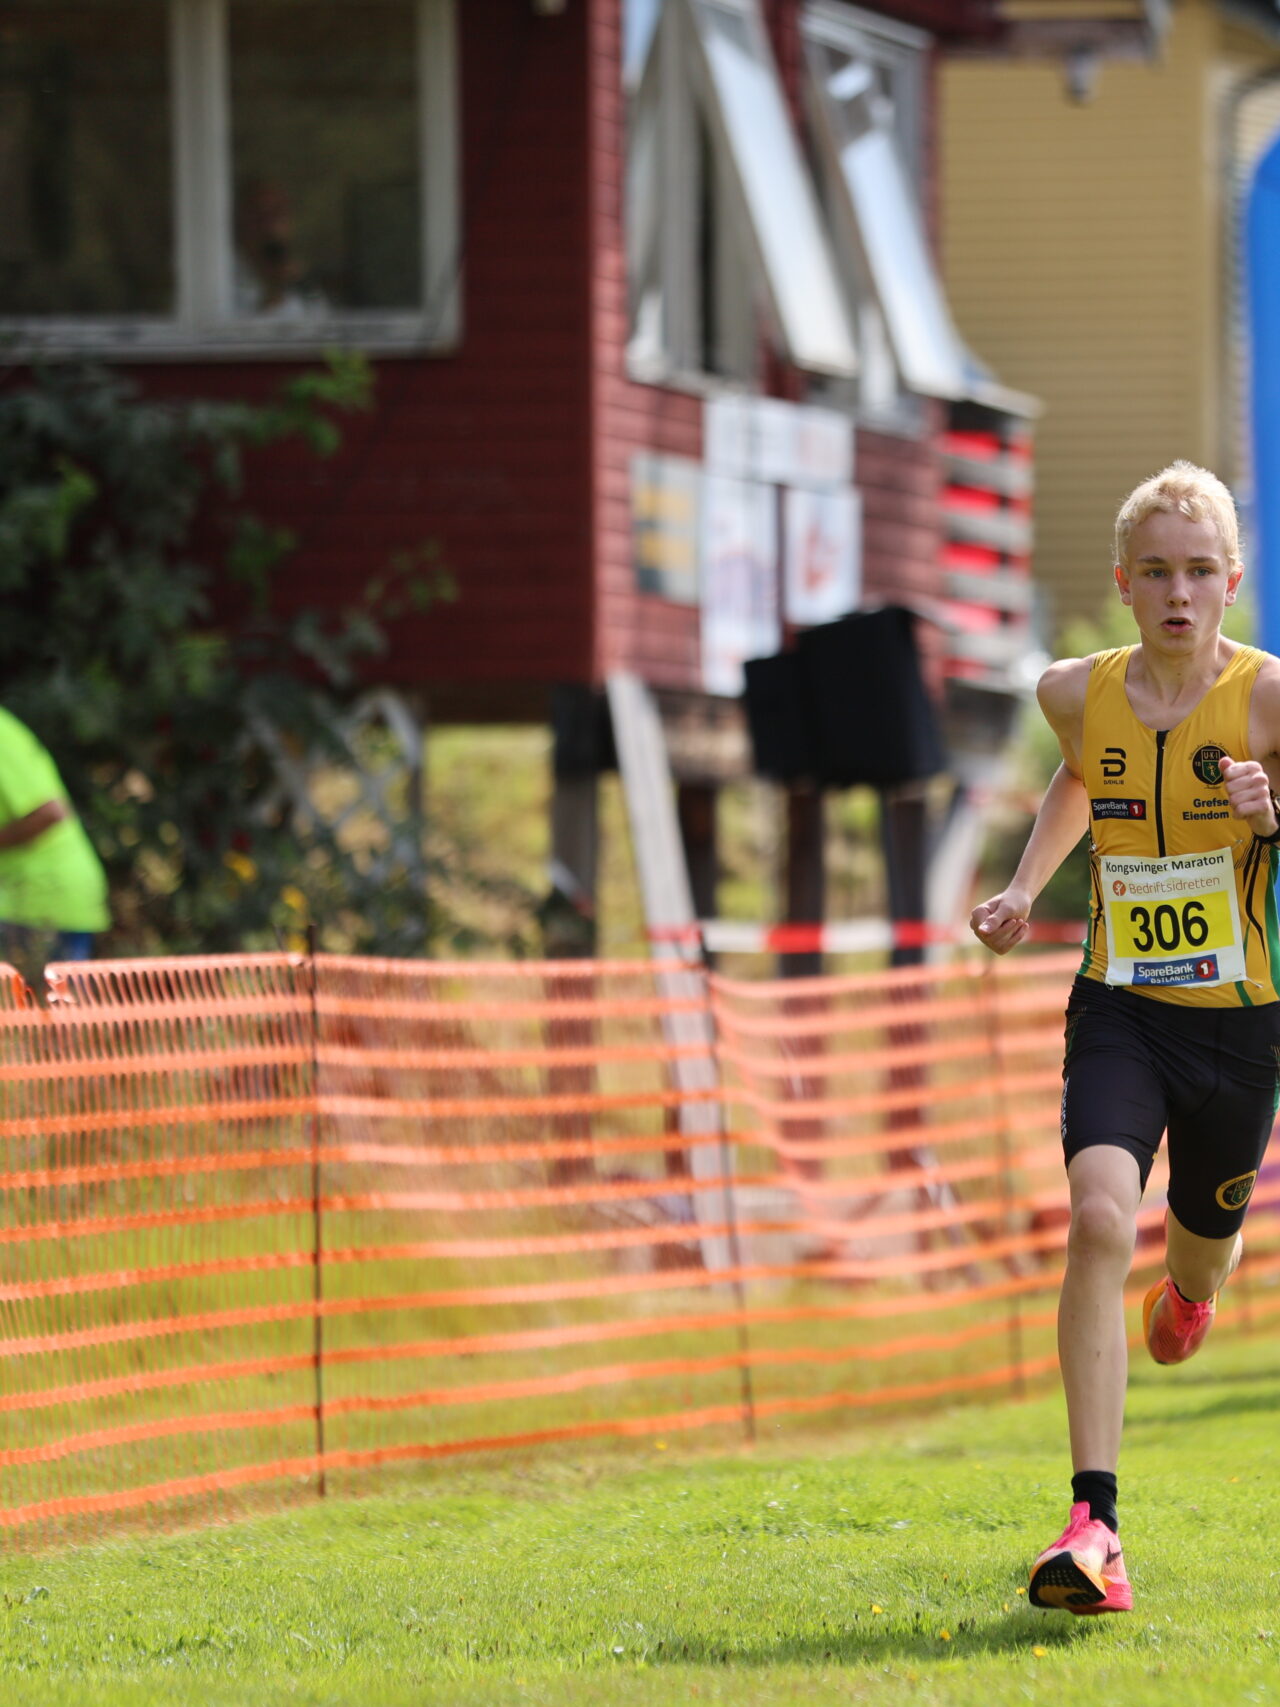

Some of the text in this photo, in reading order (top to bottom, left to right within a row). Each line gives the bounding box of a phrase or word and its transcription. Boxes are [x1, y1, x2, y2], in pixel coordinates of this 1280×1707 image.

[1093, 801, 1139, 815] SpareBank 1
[1182, 811, 1230, 821] Eiendom
[1105, 854, 1225, 875] Kongsvinger Maraton
[1128, 876, 1221, 895] Bedriftsidretten
[1130, 900, 1209, 953] 306
[1138, 962, 1209, 978] SpareBank 1
[1150, 973, 1195, 984] ØSTLANDET
